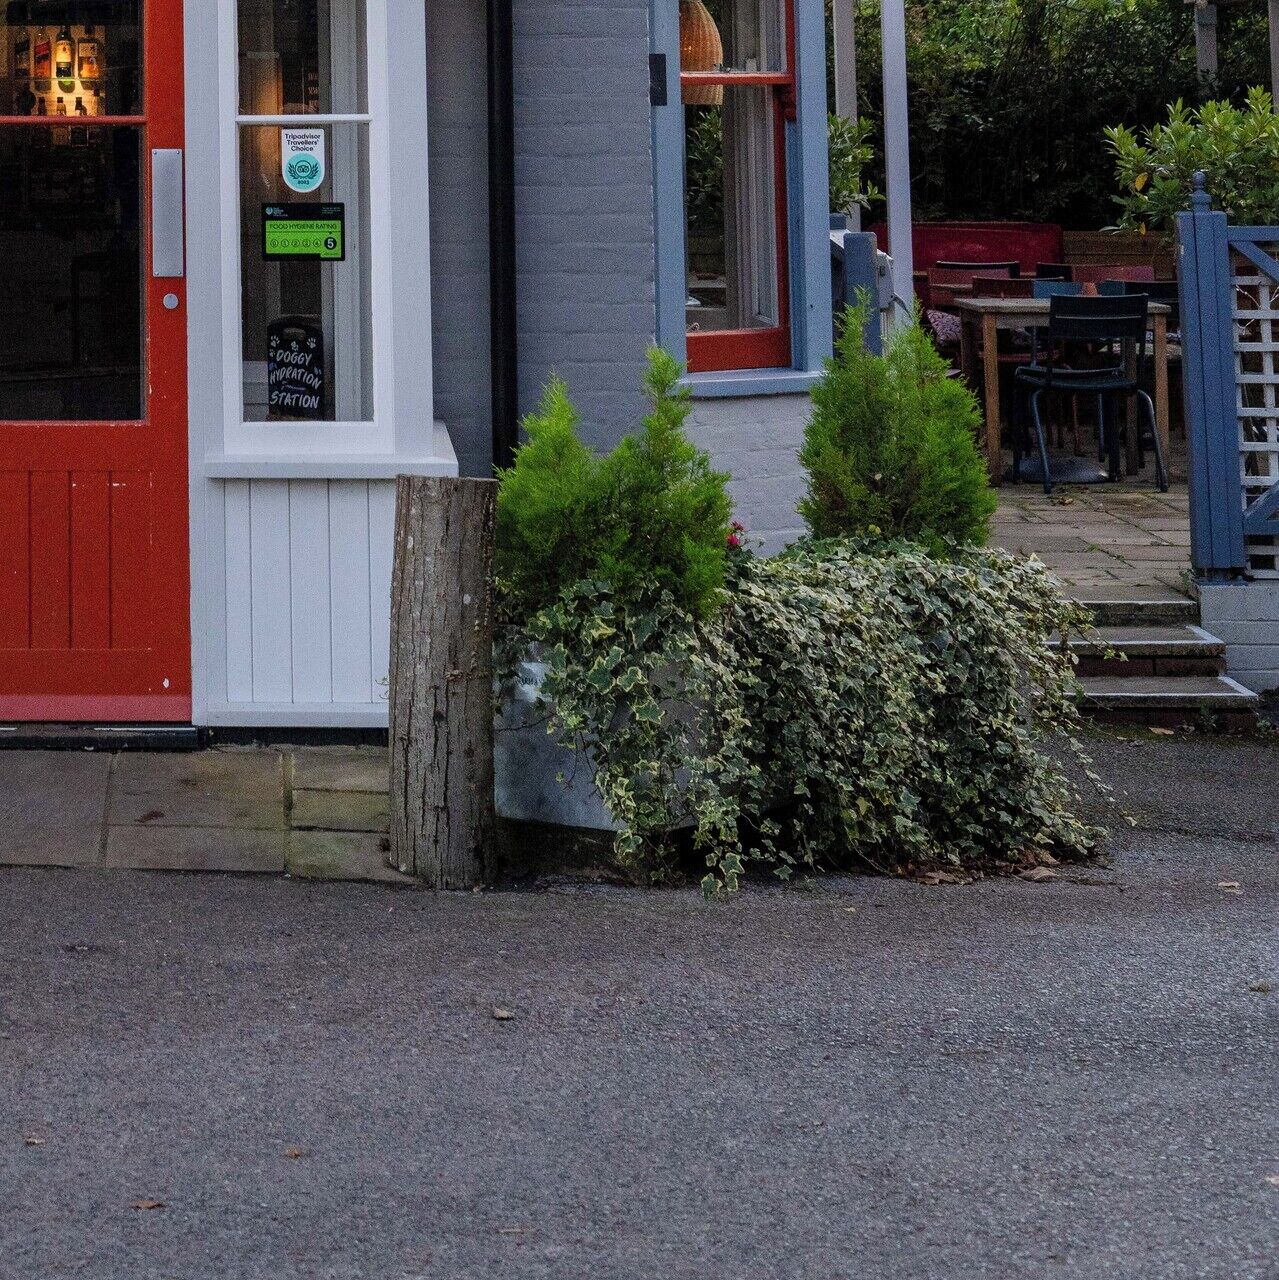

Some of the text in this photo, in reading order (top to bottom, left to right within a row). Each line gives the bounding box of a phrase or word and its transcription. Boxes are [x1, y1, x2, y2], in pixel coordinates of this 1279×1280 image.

[327, 238, 335, 249] 5
[276, 349, 313, 366] DOGGY
[269, 366, 322, 390] HYDRATION
[269, 390, 320, 409] STATION
